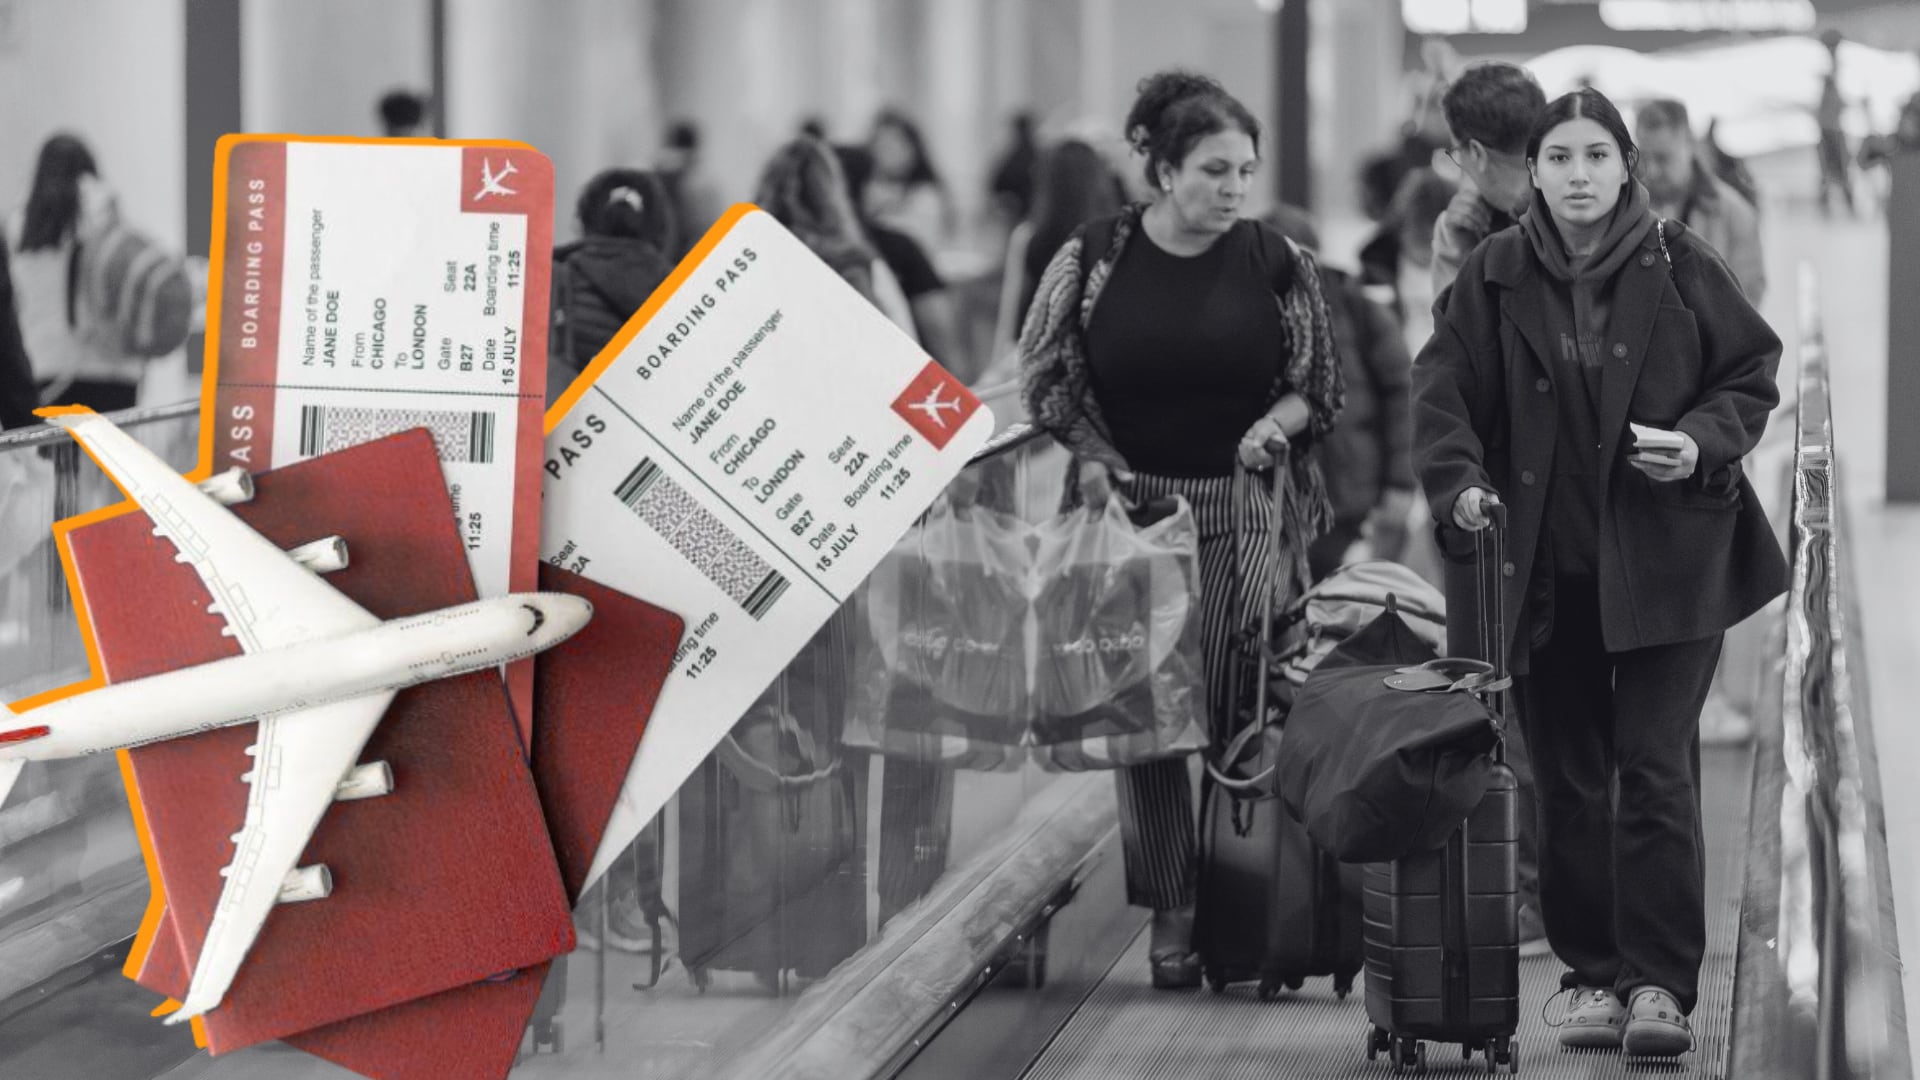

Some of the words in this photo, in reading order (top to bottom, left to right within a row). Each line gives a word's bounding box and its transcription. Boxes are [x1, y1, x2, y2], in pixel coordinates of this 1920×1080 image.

[248, 179, 265, 231] PASS
[310, 208, 324, 280] passenger
[487, 221, 500, 251] time
[443, 260, 457, 293] Seat
[463, 263, 477, 292] 22A
[483, 254, 502, 316] Boarding
[507, 249, 521, 288] 11:25
[241, 241, 263, 348] BOARDING
[307, 284, 320, 305] the
[325, 290, 339, 323] DOE
[305, 307, 318, 322] of
[636, 294, 716, 380] BOARDING
[715, 248, 758, 292] PASS
[302, 326, 316, 366] Name
[323, 327, 337, 368] JANE
[351, 332, 365, 368] From
[370, 297, 386, 370] CHICAGO
[411, 304, 427, 370] LONDON
[503, 326, 517, 365] JULY
[394, 352, 408, 369] To
[437, 337, 452, 370] Gate
[459, 344, 473, 371] B27
[482, 338, 496, 371] Date
[672, 397, 706, 431] Name
[704, 382, 718, 399] of
[713, 366, 734, 386] the
[731, 309, 783, 369] passenger
[502, 368, 515, 385] 15
[690, 408, 722, 445] JANE
[717, 380, 746, 411] DOE
[229, 405, 254, 462] ASS
[544, 414, 606, 480] PASS
[709, 433, 740, 465] From
[723, 418, 776, 475] CHICAGO
[828, 435, 856, 465] Seat
[754, 449, 805, 504] LONDON
[844, 451, 870, 477] 22A
[844, 458, 893, 508] Boarding
[887, 434, 913, 459] time
[741, 476, 760, 491] To
[880, 466, 911, 500] 11:25
[775, 493, 804, 520] Gate
[790, 509, 815, 536] B27
[468, 512, 482, 550] 11:25
[808, 522, 837, 550] Date
[816, 555, 833, 572] 15
[830, 523, 859, 558] JULY
[550, 539, 578, 568] Seat
[570, 555, 591, 576] 2A
[693, 612, 719, 638] time
[686, 645, 717, 679] 11:25
